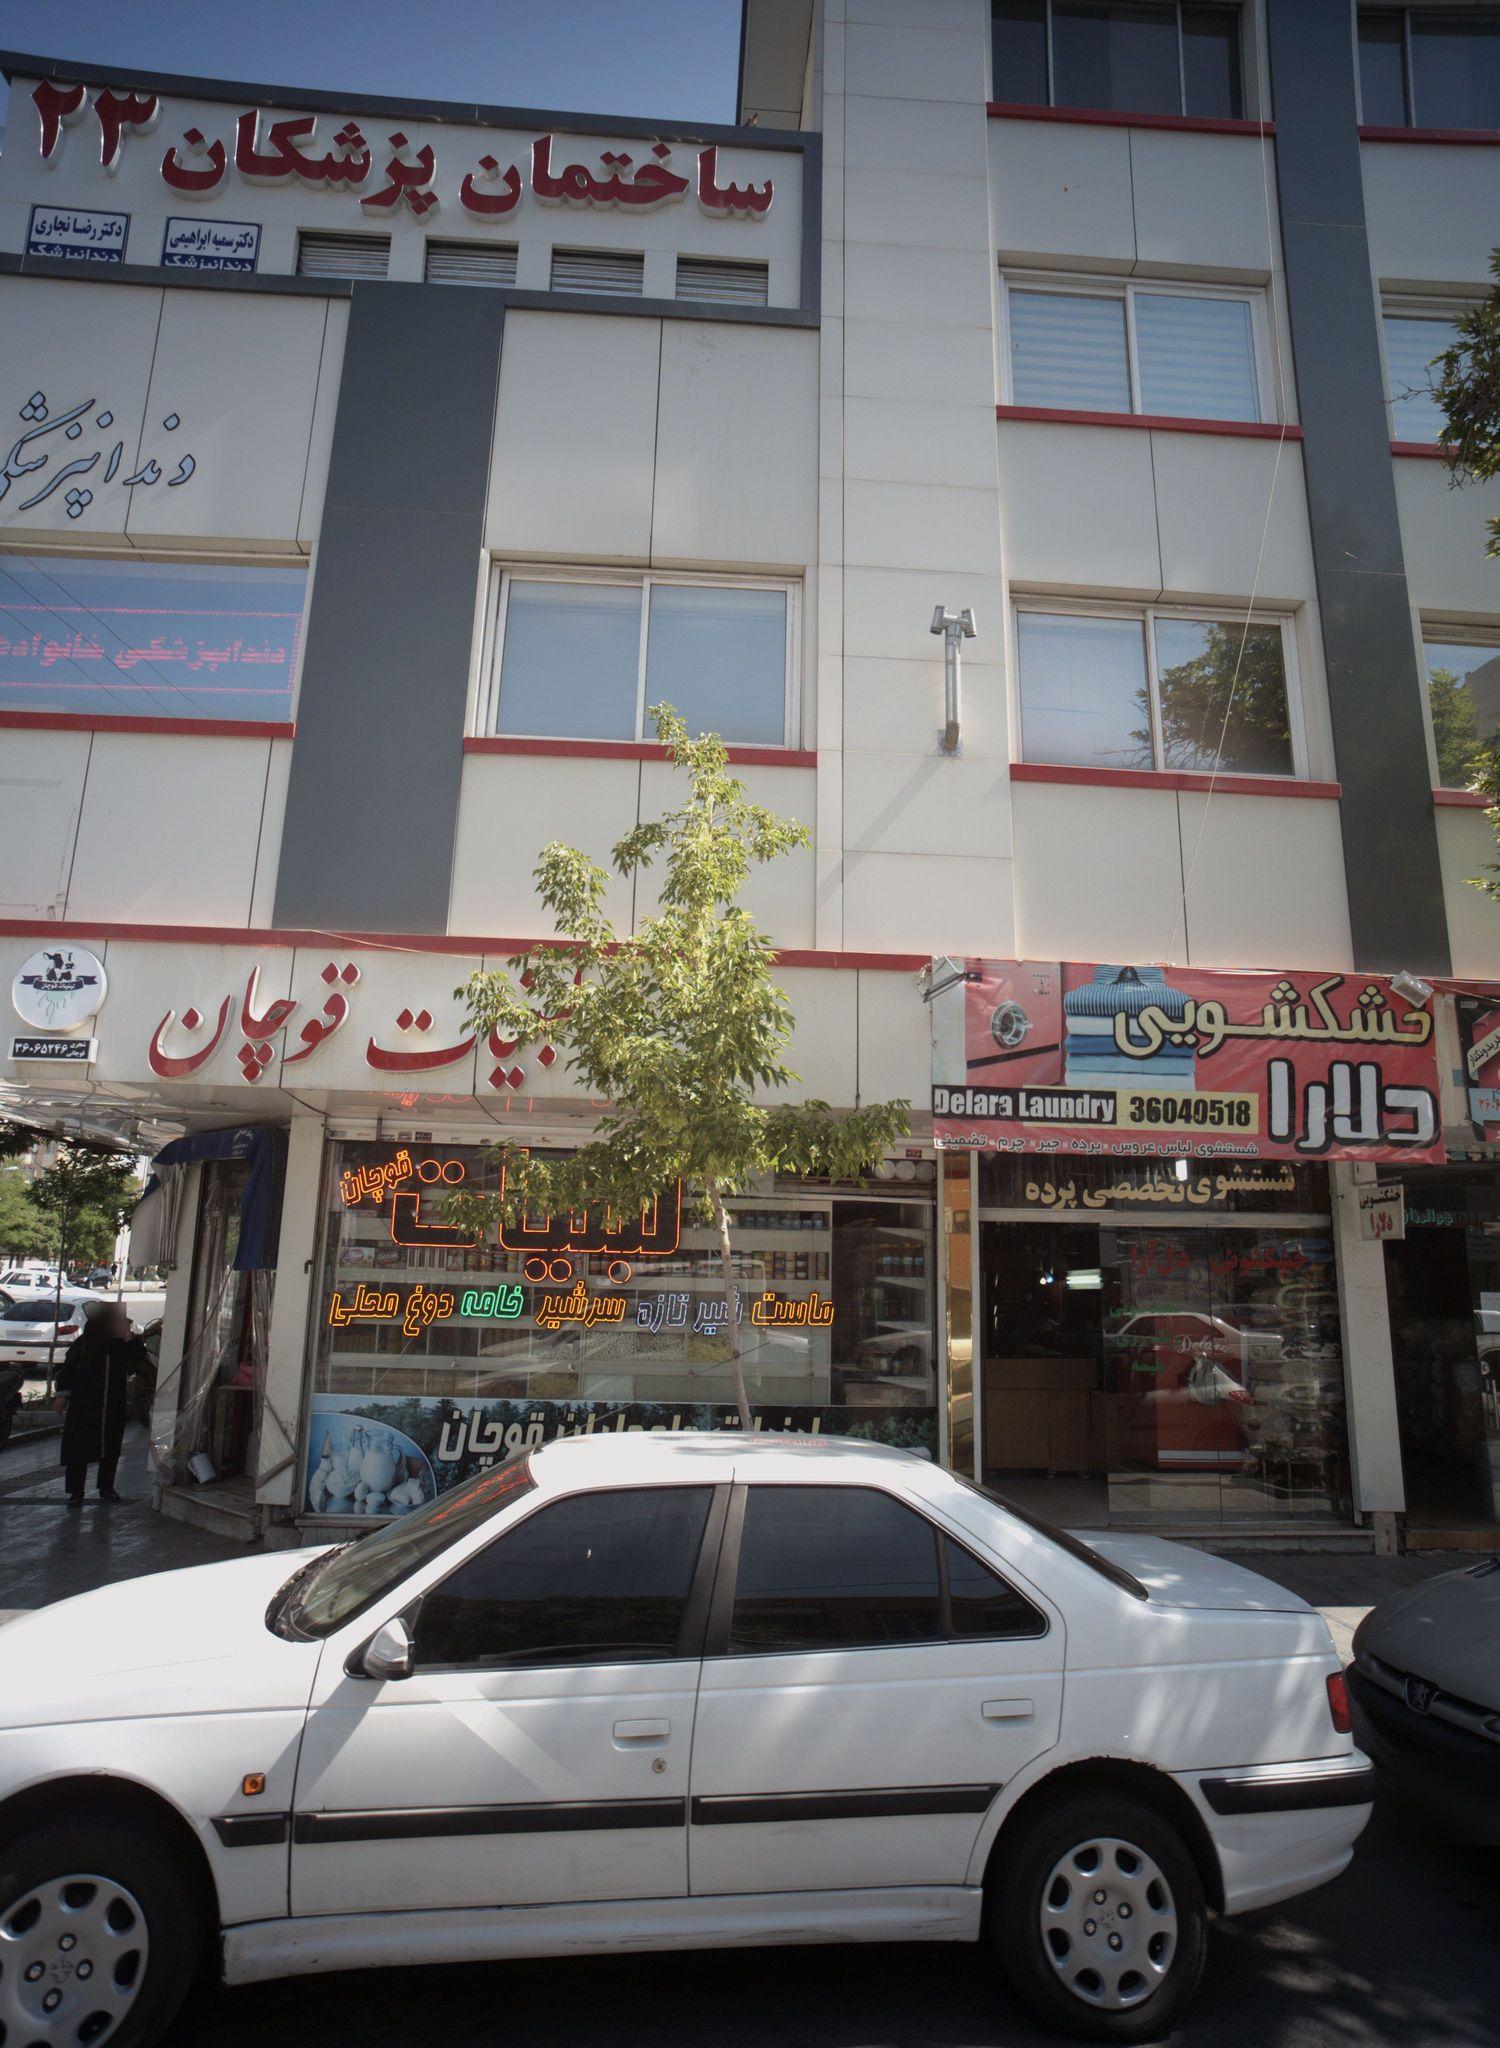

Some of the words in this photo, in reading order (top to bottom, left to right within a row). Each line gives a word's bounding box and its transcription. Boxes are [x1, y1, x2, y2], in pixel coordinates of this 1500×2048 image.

[159, 109, 441, 225] پزشکان
[459, 133, 776, 222] ساختمان
[35, 215, 71, 237] نجاری
[72, 217, 97, 240] رضا
[97, 221, 122, 241] دکتر
[232, 231, 254, 254] دکتر
[0, 391, 196, 519] دندانپزشک
[148, 961, 361, 1084] قوچان
[1112, 975, 1434, 1059] خشکشویی
[935, 1086, 1013, 1120] Delara
[1018, 1089, 1115, 1124] Laundry
[1129, 1097, 1252, 1128] 36040518
[1267, 1057, 1441, 1154] دلارا
[935, 1133, 988, 1149] تضمینی
[997, 1136, 1025, 1152] چرم
[1036, 1138, 1061, 1153] جیر
[1071, 1138, 1103, 1154] پرده
[1112, 1140, 1155, 1156] عروس
[1158, 1139, 1192, 1155] لباس
[1195, 1140, 1259, 1158] شستشوی
[339, 1149, 414, 1207] قوچان
[1025, 1180, 1076, 1210] پرده
[1083, 1174, 1185, 1208] تخصصی
[1187, 1164, 1296, 1204] شستشوی
[328, 1285, 400, 1328] محلی
[403, 1285, 454, 1336] دوغ
[460, 1284, 525, 1320] خامه
[535, 1280, 627, 1329] سرشیر
[635, 1294, 690, 1333] تازه
[694, 1285, 743, 1336] شیر
[751, 1292, 835, 1327] ماست
[437, 1409, 546, 1473] قوچان
